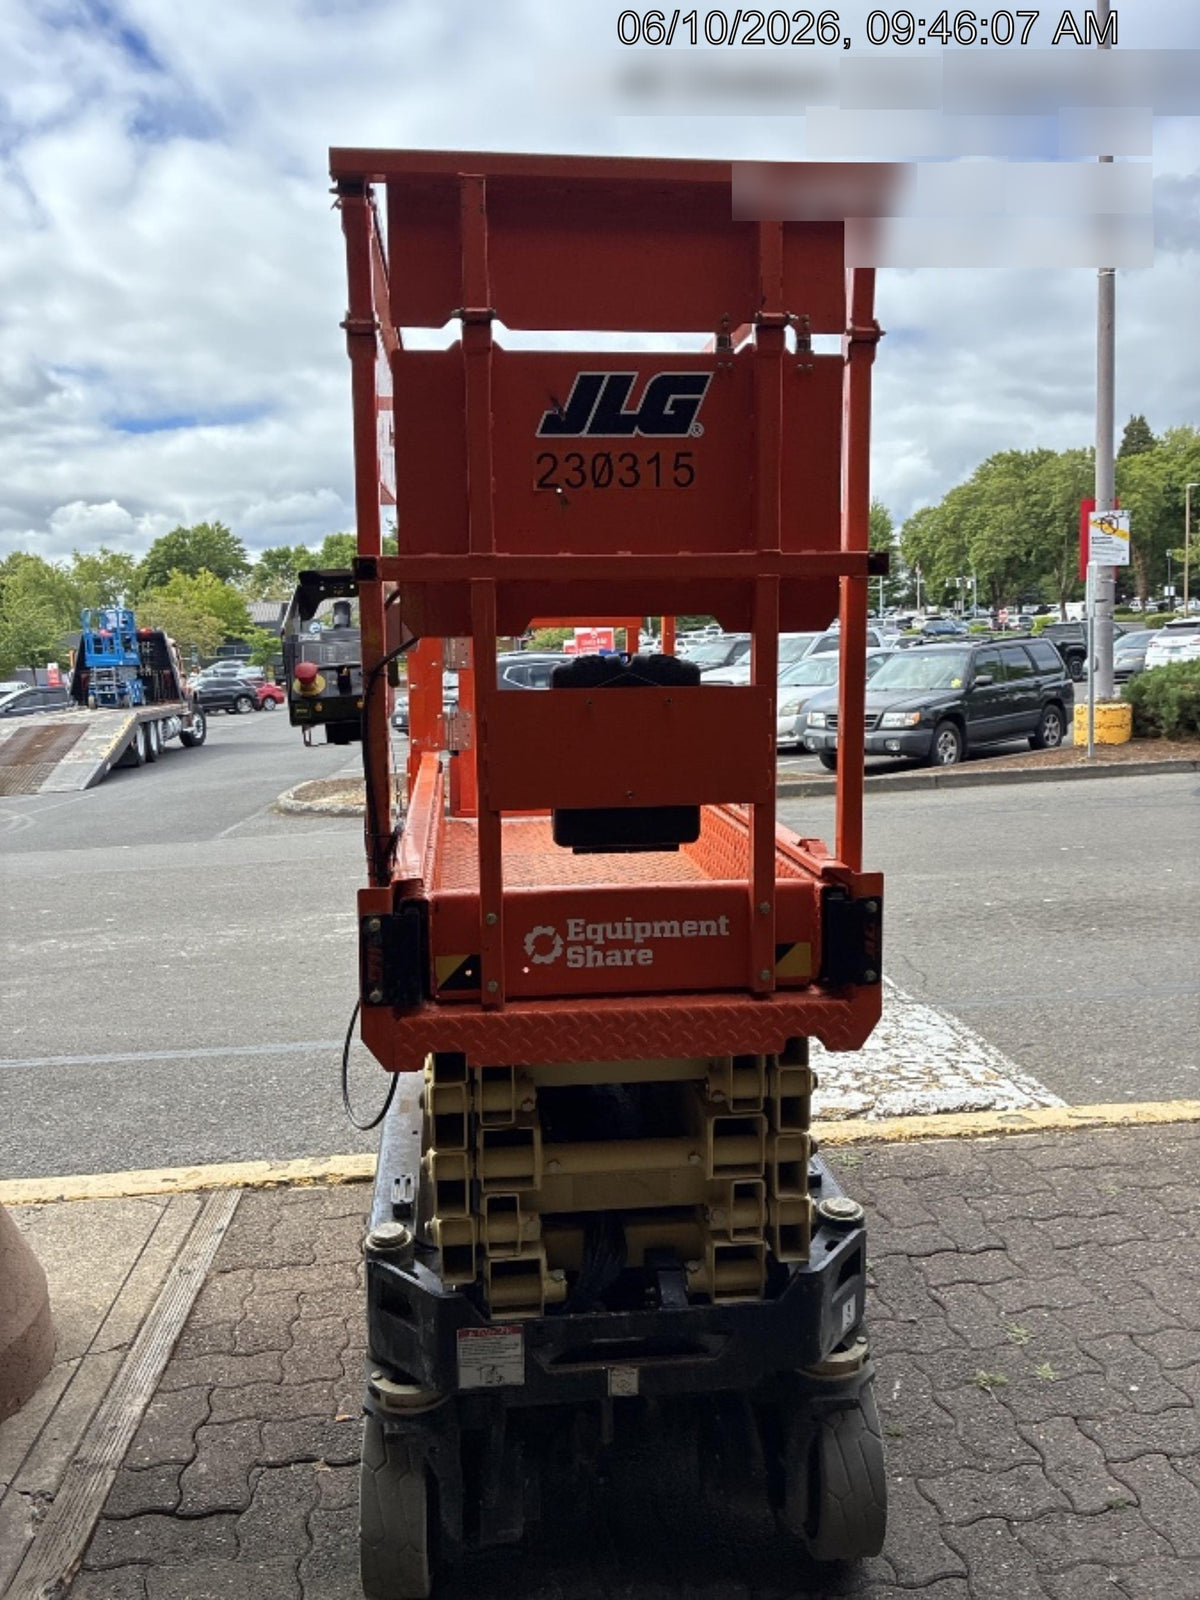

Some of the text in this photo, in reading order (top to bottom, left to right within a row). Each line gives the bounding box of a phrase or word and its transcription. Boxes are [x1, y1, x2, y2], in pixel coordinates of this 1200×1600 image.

[536, 452, 695, 488] 230315
[566, 915, 730, 944] Equipment
[566, 946, 654, 968] Share
